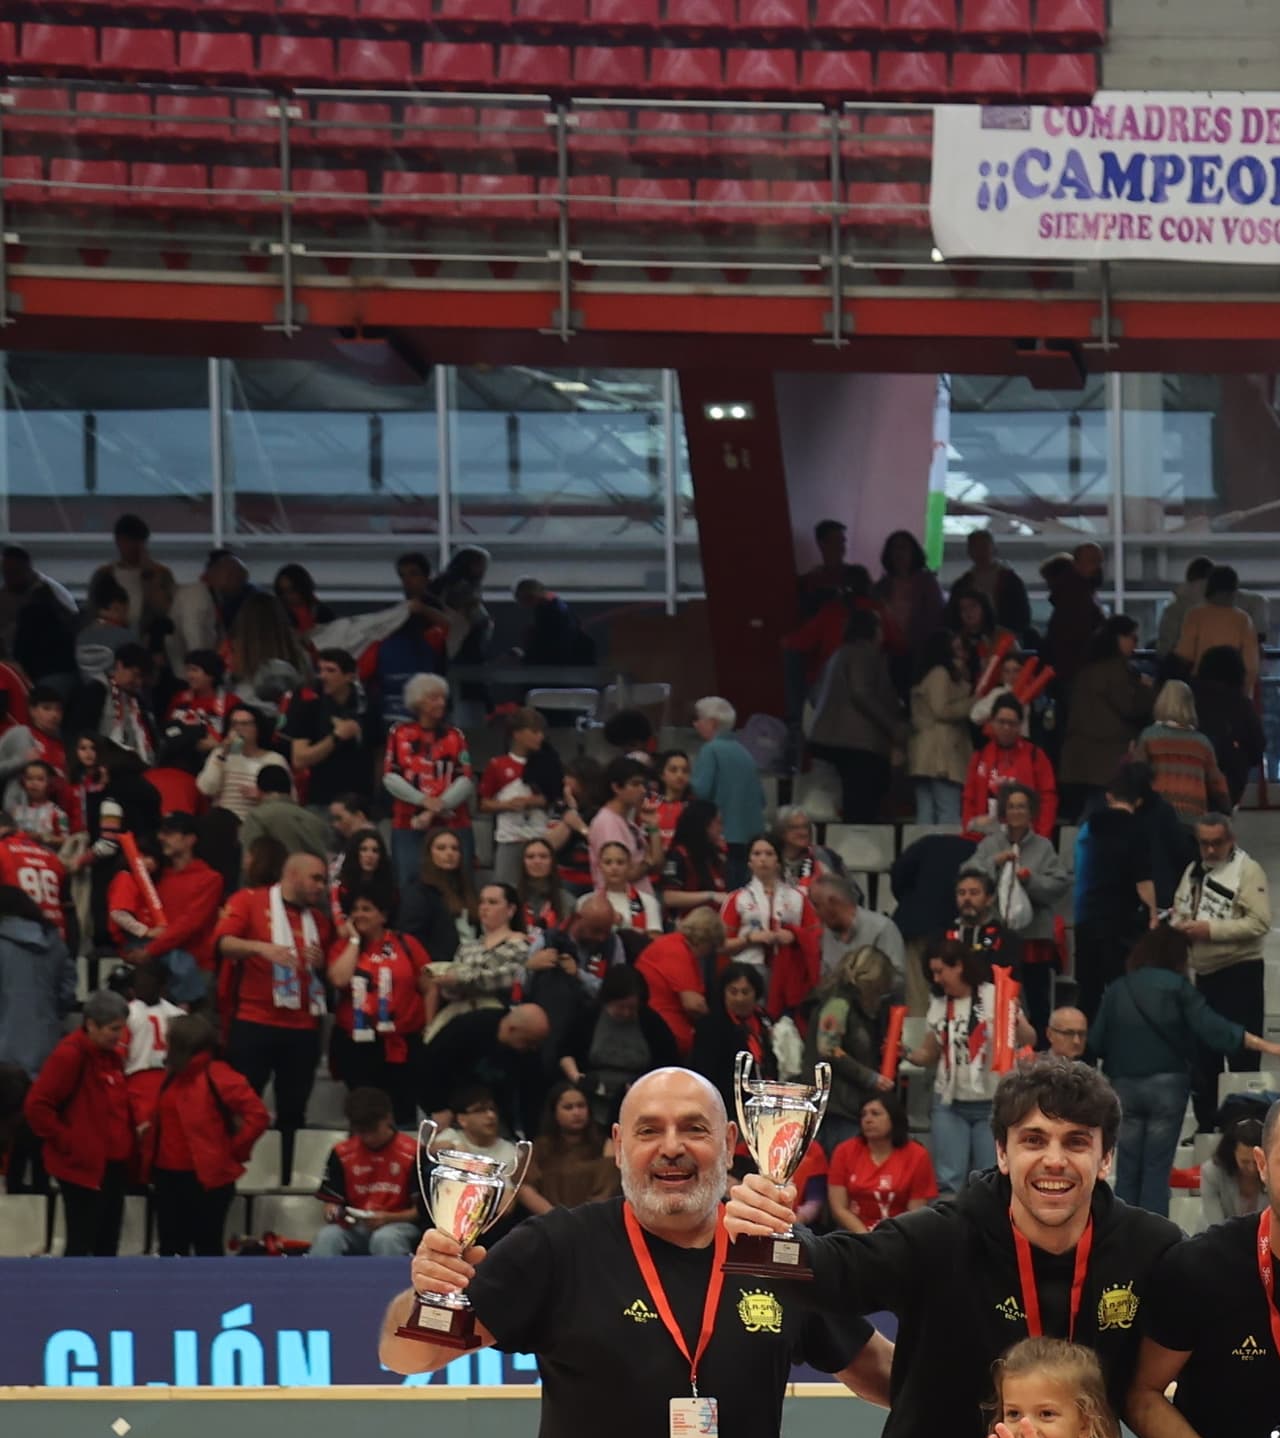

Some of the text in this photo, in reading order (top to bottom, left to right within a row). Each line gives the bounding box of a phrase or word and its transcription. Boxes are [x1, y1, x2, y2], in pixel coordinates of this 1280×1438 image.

[1043, 104, 1232, 145] COMADRES
[1039, 211, 1153, 242] SIEMPRE
[1159, 215, 1214, 245] CON
[623, 1307, 659, 1321] ALTAN
[1231, 1346, 1267, 1358] ALTAN
